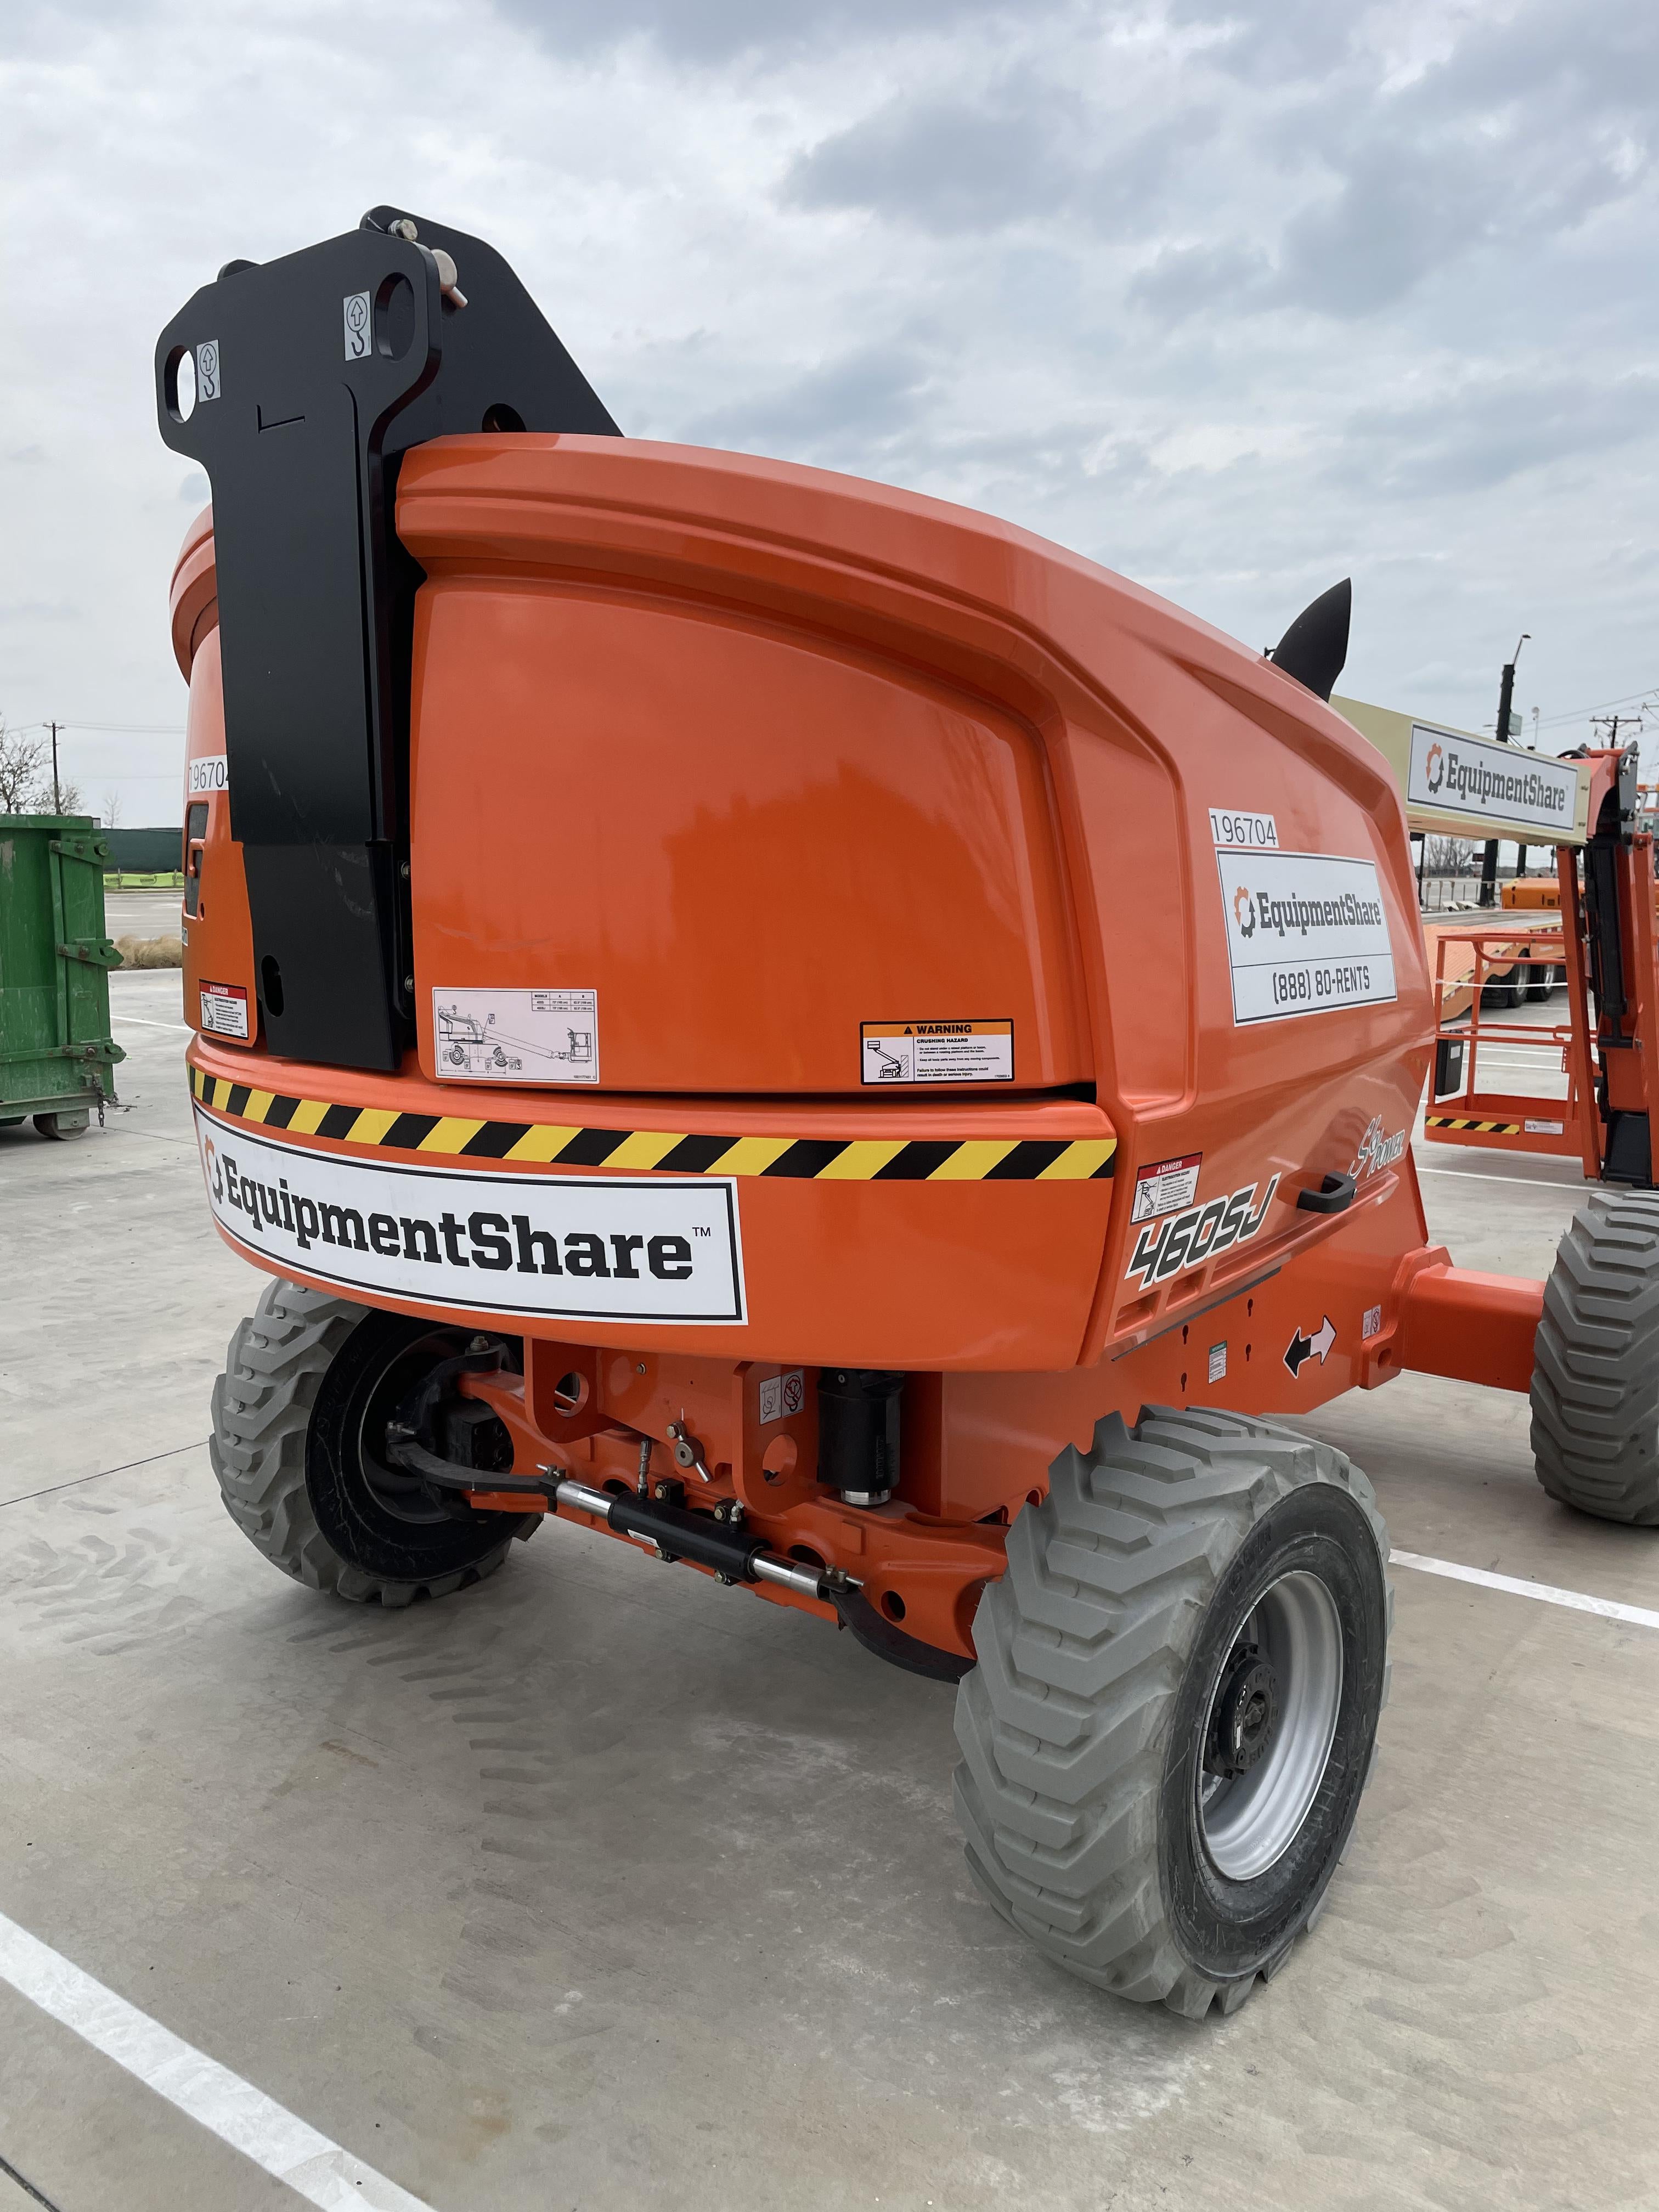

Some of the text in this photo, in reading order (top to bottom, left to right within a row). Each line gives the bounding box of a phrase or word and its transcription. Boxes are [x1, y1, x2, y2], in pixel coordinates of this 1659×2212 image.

[1446, 753, 1565, 811] EquipmentShare
[1210, 815, 1276, 845] 196704
[1256, 892, 1381, 936] EquipmentShare
[1273, 966, 1370, 1005] (888) 80-RENTS
[916, 1024, 972, 1034] WARNING
[1161, 1161, 1182, 1173] DANGER
[222, 1153, 693, 1280] EquipmentShare
[1126, 1173, 1280, 1290] 460SJ
